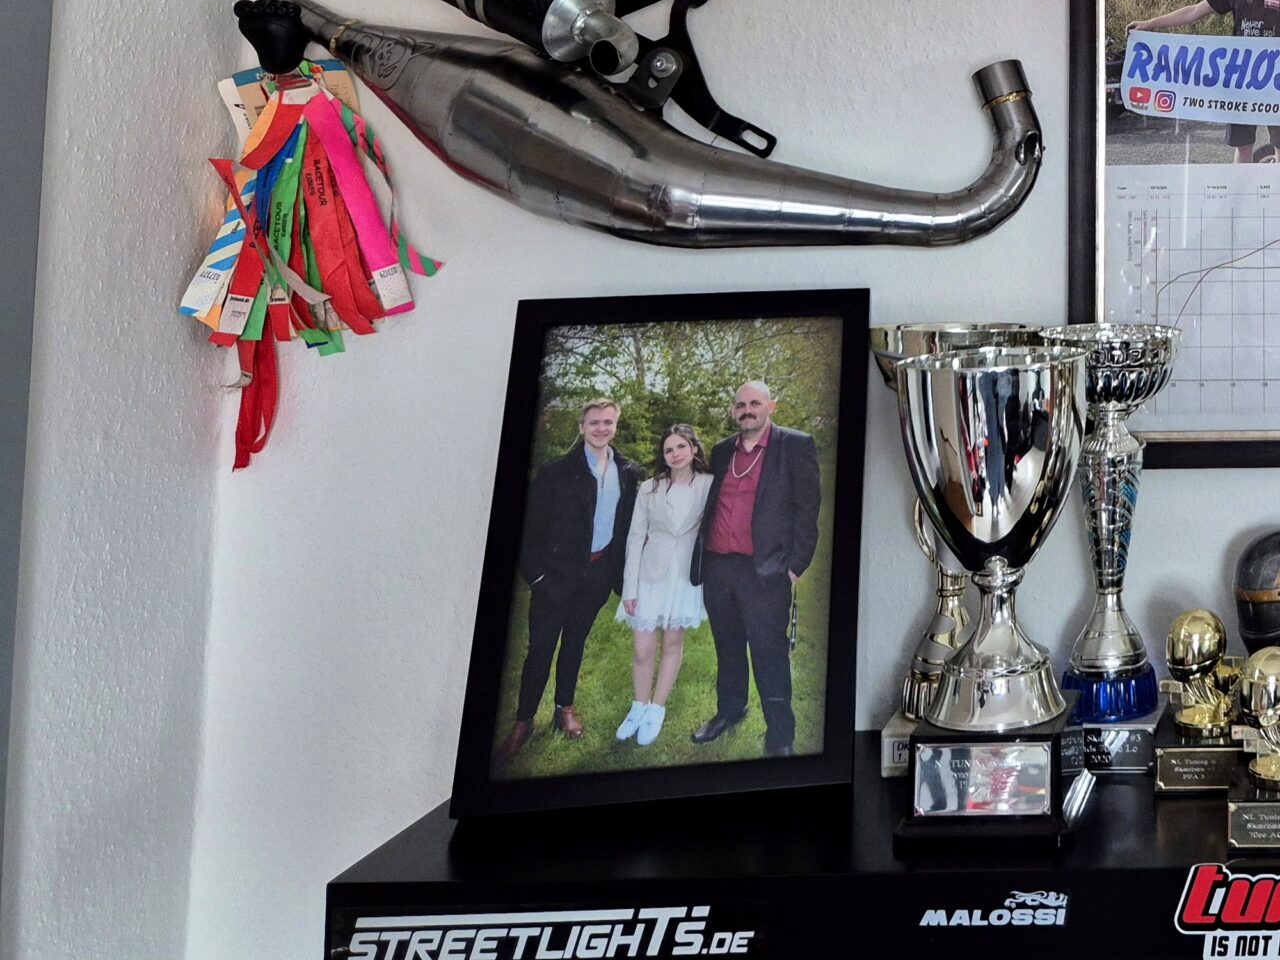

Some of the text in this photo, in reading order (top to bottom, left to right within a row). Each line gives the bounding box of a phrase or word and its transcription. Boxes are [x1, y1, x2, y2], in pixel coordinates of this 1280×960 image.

[1183, 97, 1205, 108] TWO
[1207, 99, 1248, 112] STROKE
[918, 907, 1067, 927] MALOSSI
[1210, 935, 1229, 957] IS
[1235, 935, 1273, 957] NOT
